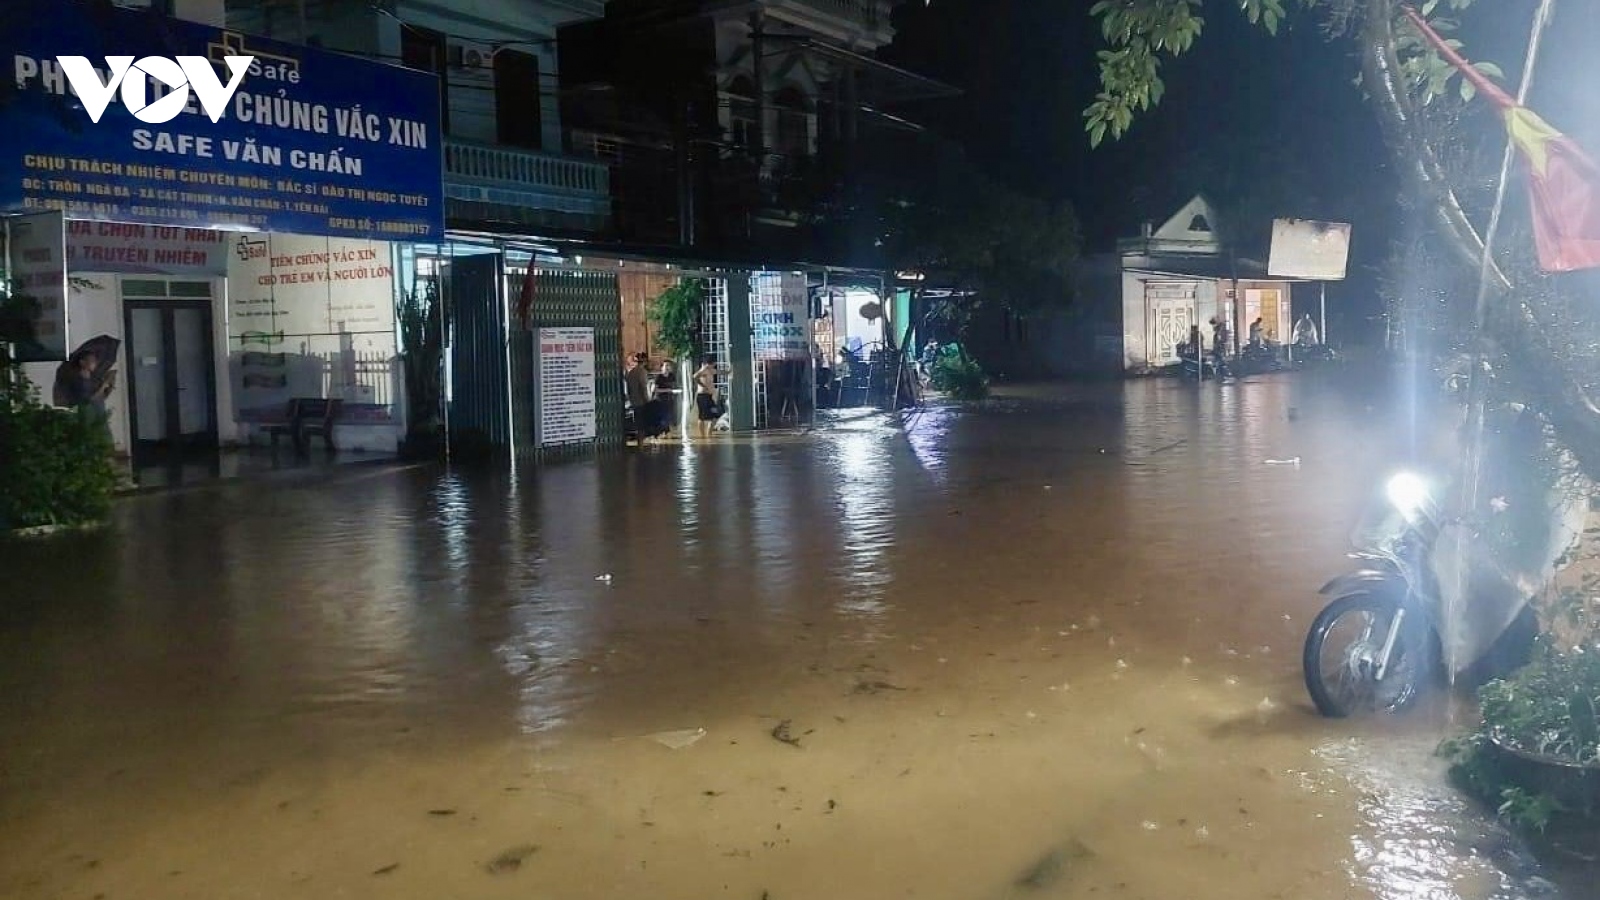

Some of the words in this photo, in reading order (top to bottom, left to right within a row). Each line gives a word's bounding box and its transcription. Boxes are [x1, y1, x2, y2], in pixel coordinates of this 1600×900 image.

[248, 58, 300, 84] Safe
[235, 88, 329, 134] CHỦNG
[334, 103, 381, 142] VẮC
[388, 117, 427, 149] XIN
[24, 154, 65, 171] CHỊU
[70, 159, 122, 176] TRÁCH
[132, 128, 214, 158] SAFE
[222, 137, 281, 166] VĂN
[290, 146, 362, 176] CHẤN
